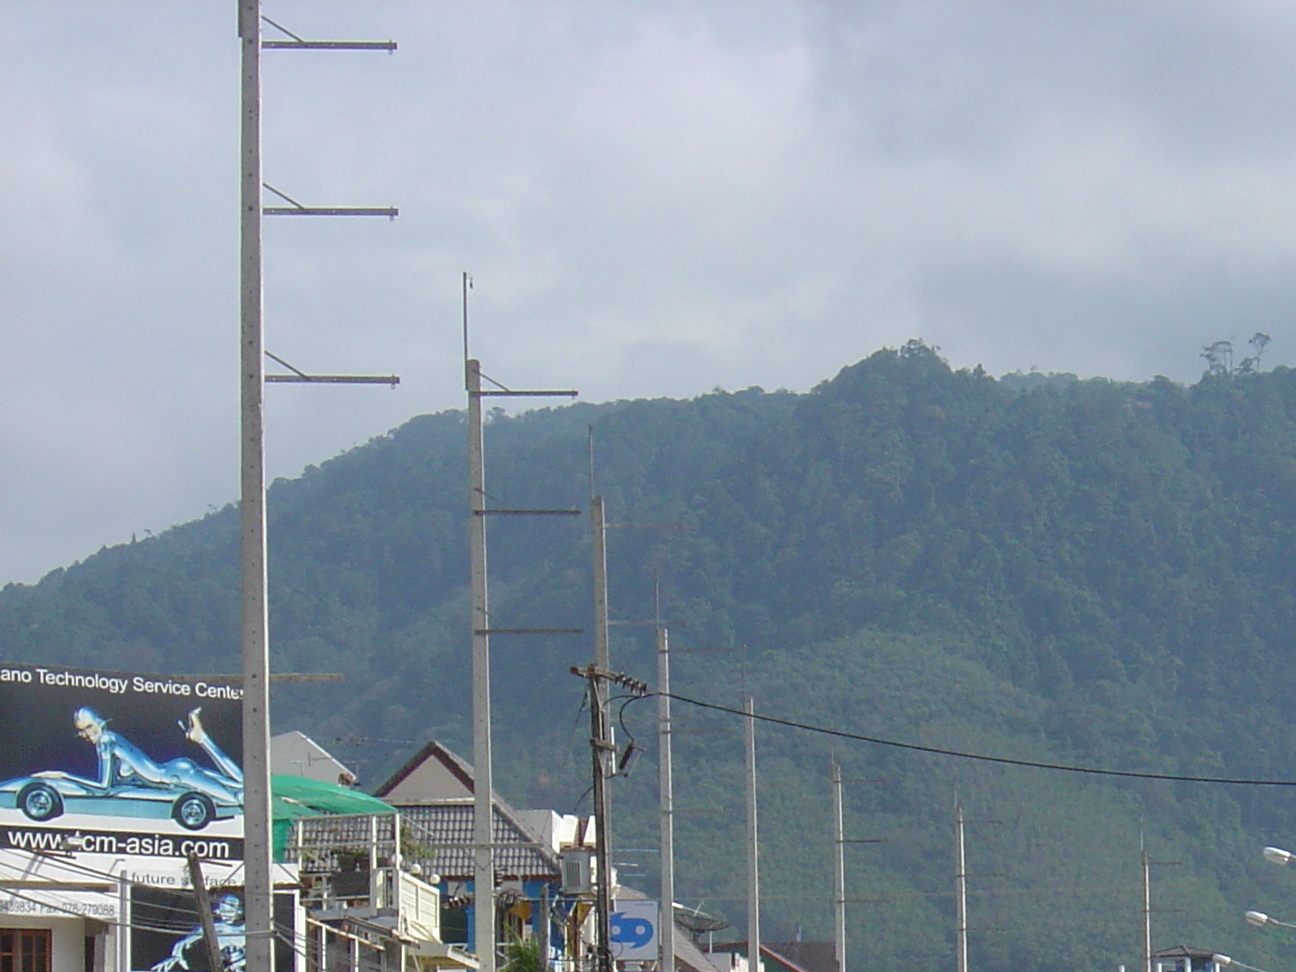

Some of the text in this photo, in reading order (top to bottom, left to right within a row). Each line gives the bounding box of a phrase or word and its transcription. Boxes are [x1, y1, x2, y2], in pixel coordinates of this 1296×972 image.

[36, 668, 128, 693] Technology
[133, 677, 191, 696] Service
[132, 873, 176, 885] future
[180, 876, 237, 888] sface
